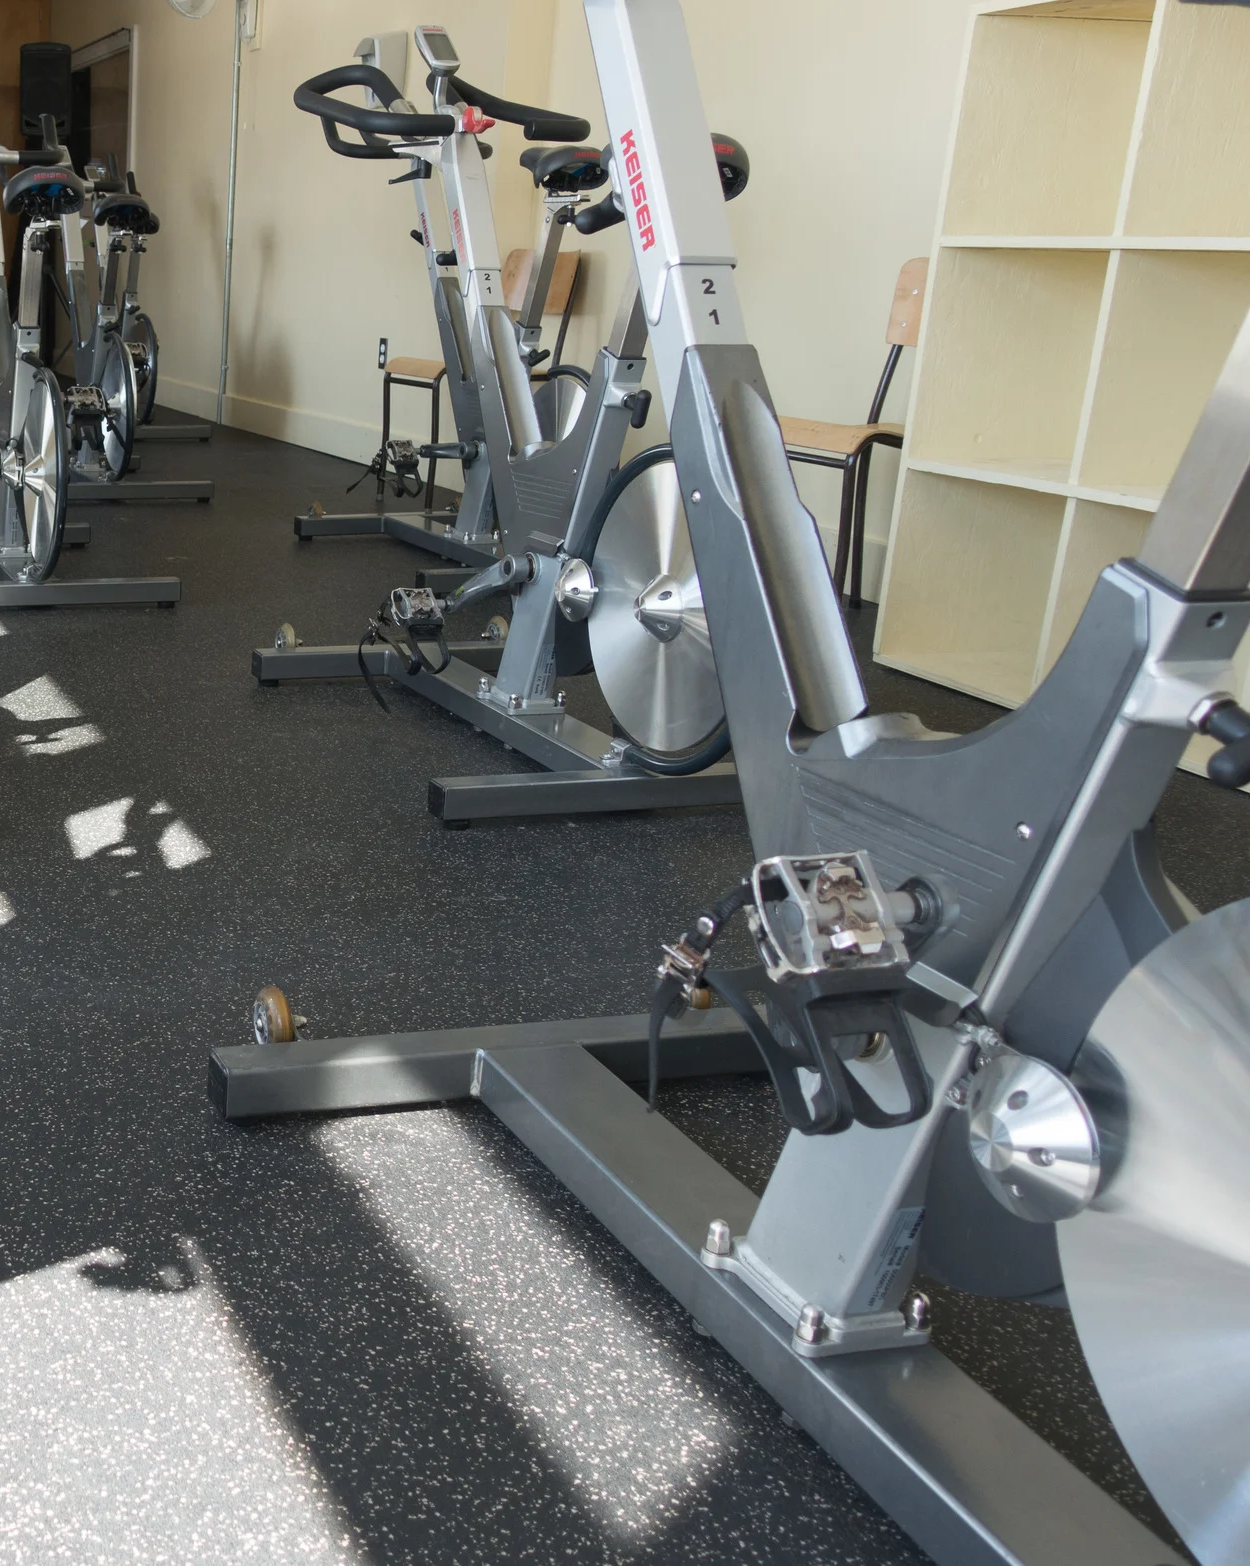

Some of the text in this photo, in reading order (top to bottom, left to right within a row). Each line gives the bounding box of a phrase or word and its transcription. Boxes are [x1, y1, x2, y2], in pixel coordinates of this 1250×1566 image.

[34, 172, 68, 181] KEISER
[620, 129, 656, 252] KEISER
[420, 212, 430, 248] KEISER
[452, 208, 467, 264] KEISER
[701, 279, 716, 294] 2
[708, 309, 720, 325] 1
